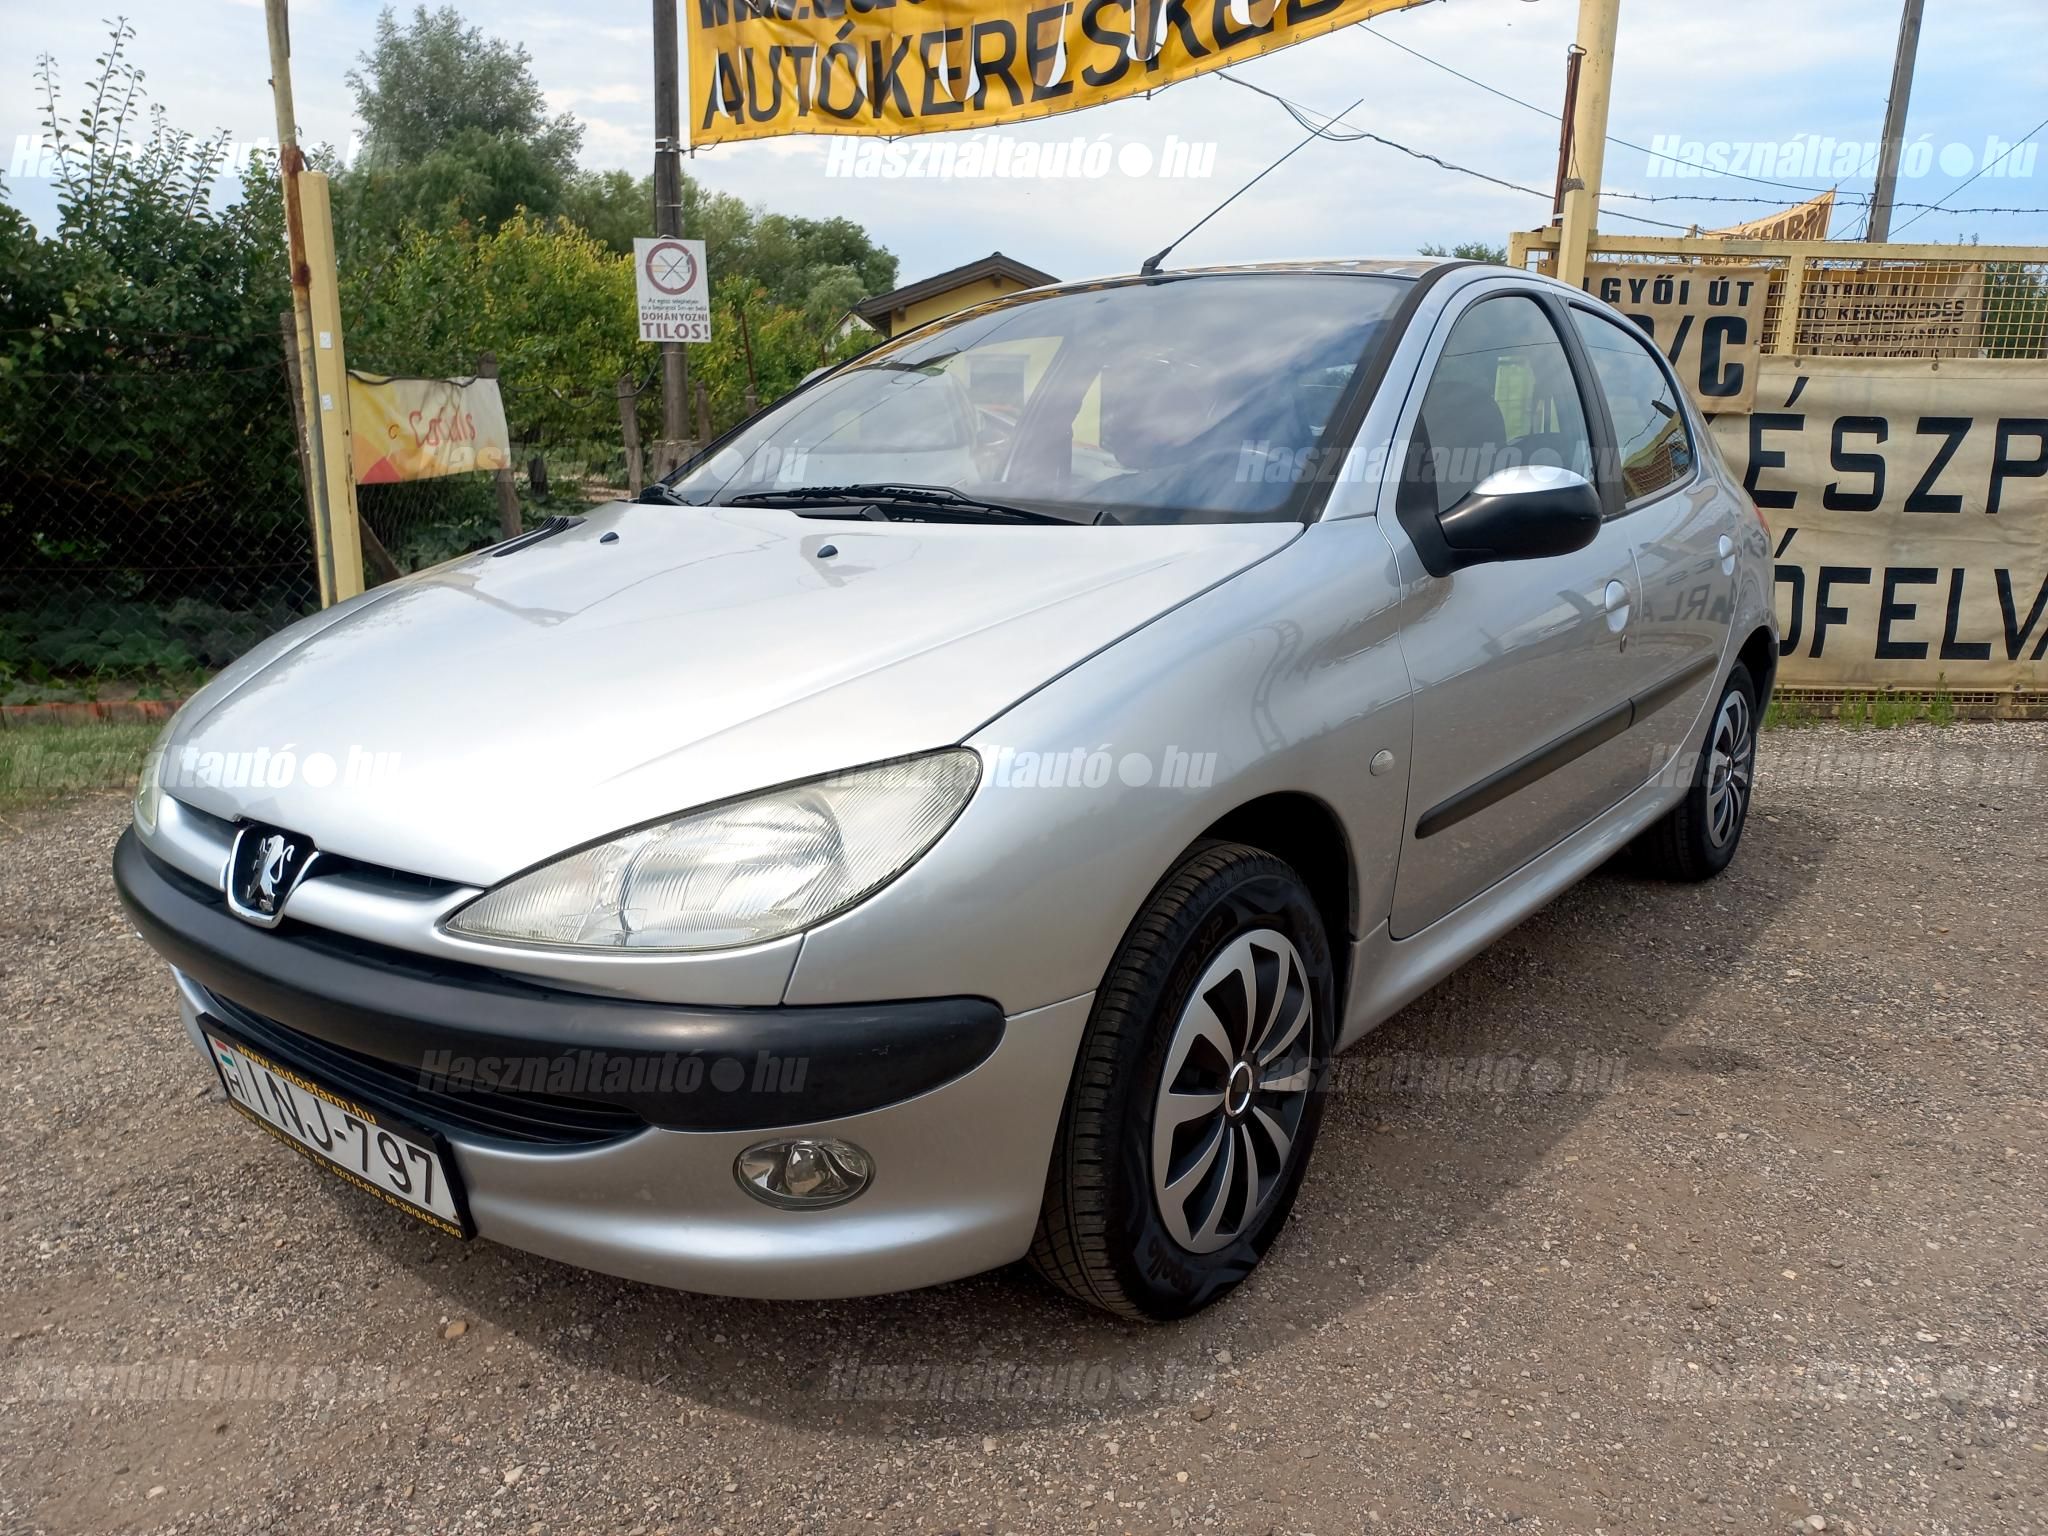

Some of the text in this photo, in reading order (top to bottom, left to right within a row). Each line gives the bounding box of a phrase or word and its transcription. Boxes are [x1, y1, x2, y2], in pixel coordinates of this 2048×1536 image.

[641, 311, 708, 322] DOHÁNYOZNI
[1583, 275, 1754, 306] GYŐI ÚT
[642, 322, 710, 340] TILOS!
[1706, 377, 2048, 514] ÉSZP
[237, 1044, 377, 1125] www.autosfarm.hu
[224, 1060, 432, 1205] H INJ-797
